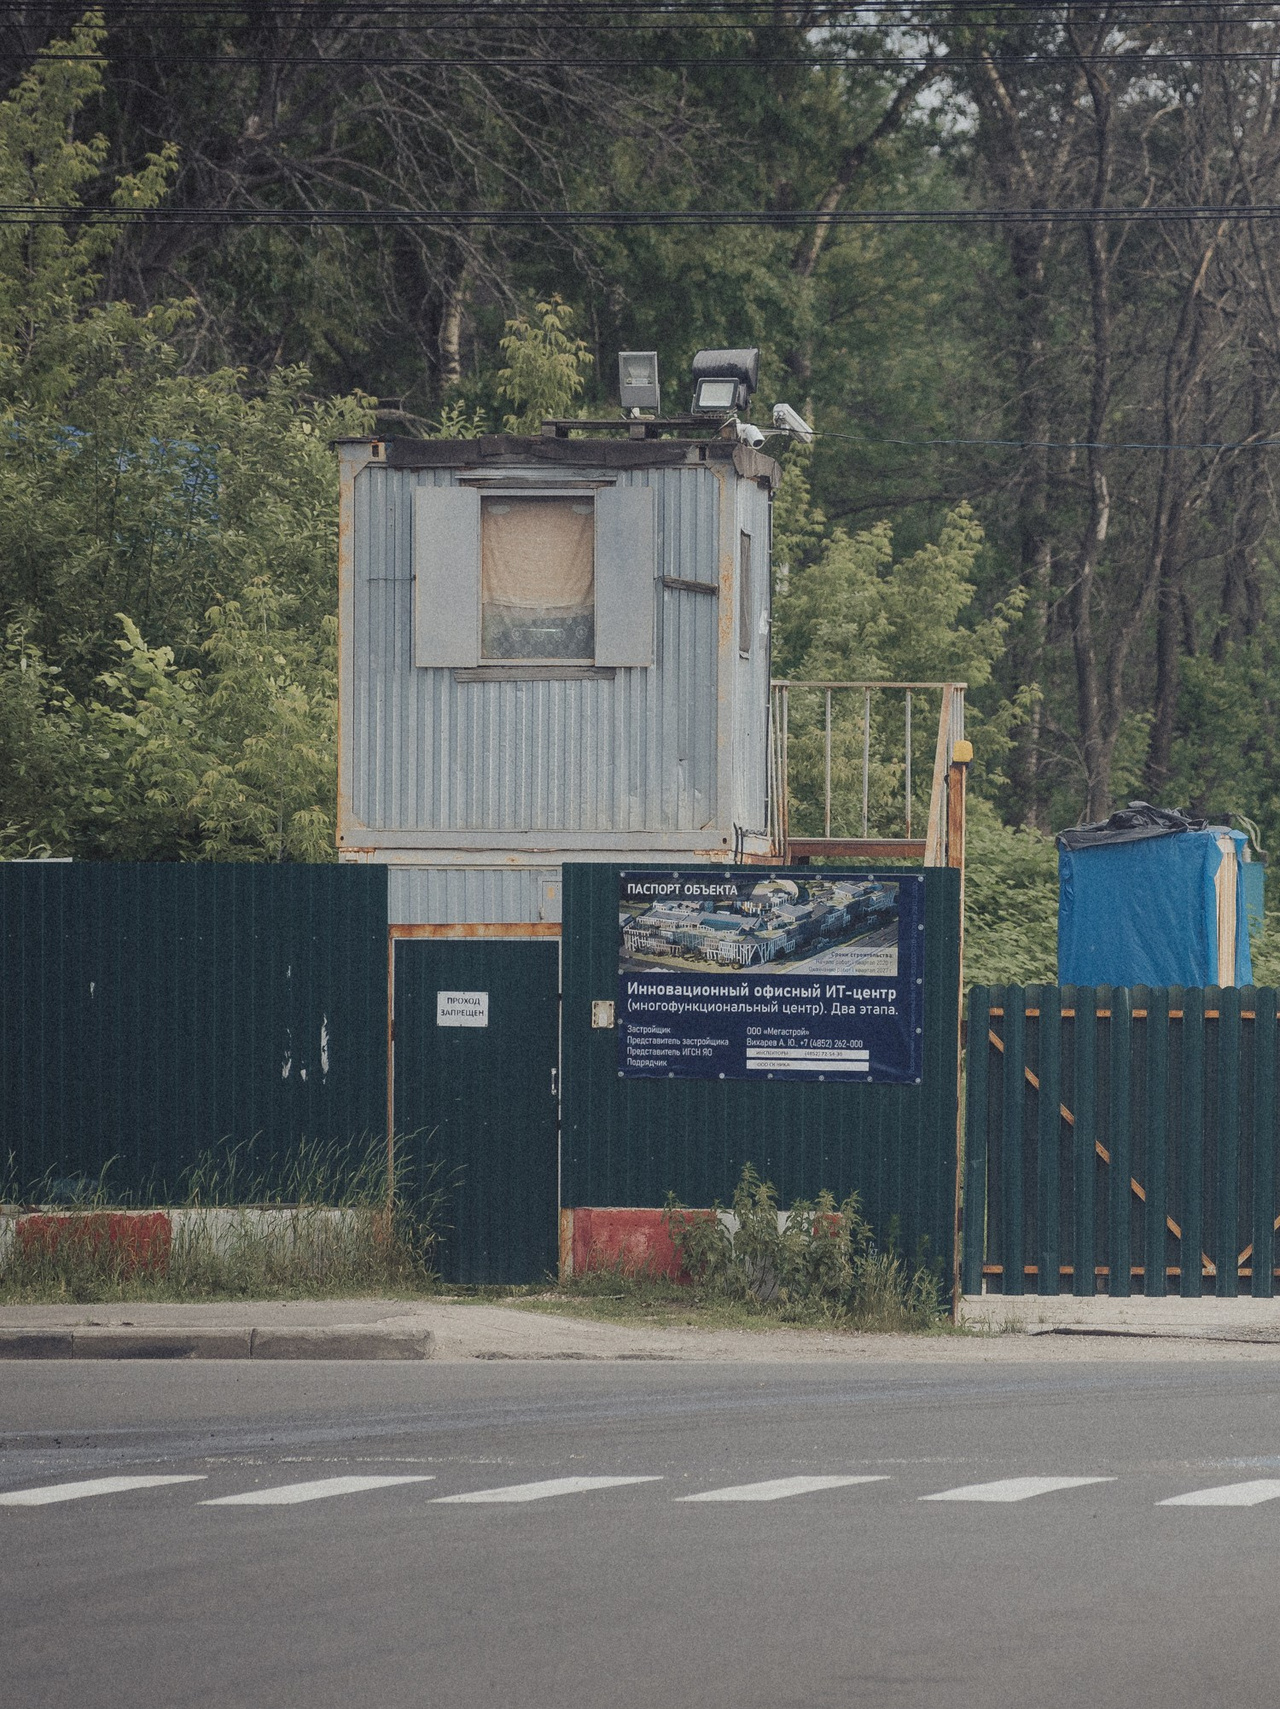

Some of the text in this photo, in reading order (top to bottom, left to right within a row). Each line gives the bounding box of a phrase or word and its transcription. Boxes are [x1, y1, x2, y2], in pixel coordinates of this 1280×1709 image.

[627, 883, 738, 896] ПАСПОРТ ОБЪЕКТА
[627, 982, 897, 1002] Инновационный офисный ИТ-центр
[447, 997, 481, 1006] ПРОХОД
[627, 999, 899, 1016] (многофункциональный центр). Два этапа.
[440, 1009, 484, 1018] ЗАПРЕЩЕН
[627, 1024, 671, 1035] Застройщик
[746, 1026, 810, 1038] ООО «Мегастрой»
[627, 1036, 729, 1047] Представитель застройщика
[746, 1037, 777, 1048] Вихарев
[800, 1039, 808, 1047] +7
[809, 1039, 833, 1049] (4852)
[834, 1039, 863, 1048] 262-000
[627, 1047, 713, 1057] Представитель ИГСН ЯО
[627, 1058, 668, 1068] Подрядчик
